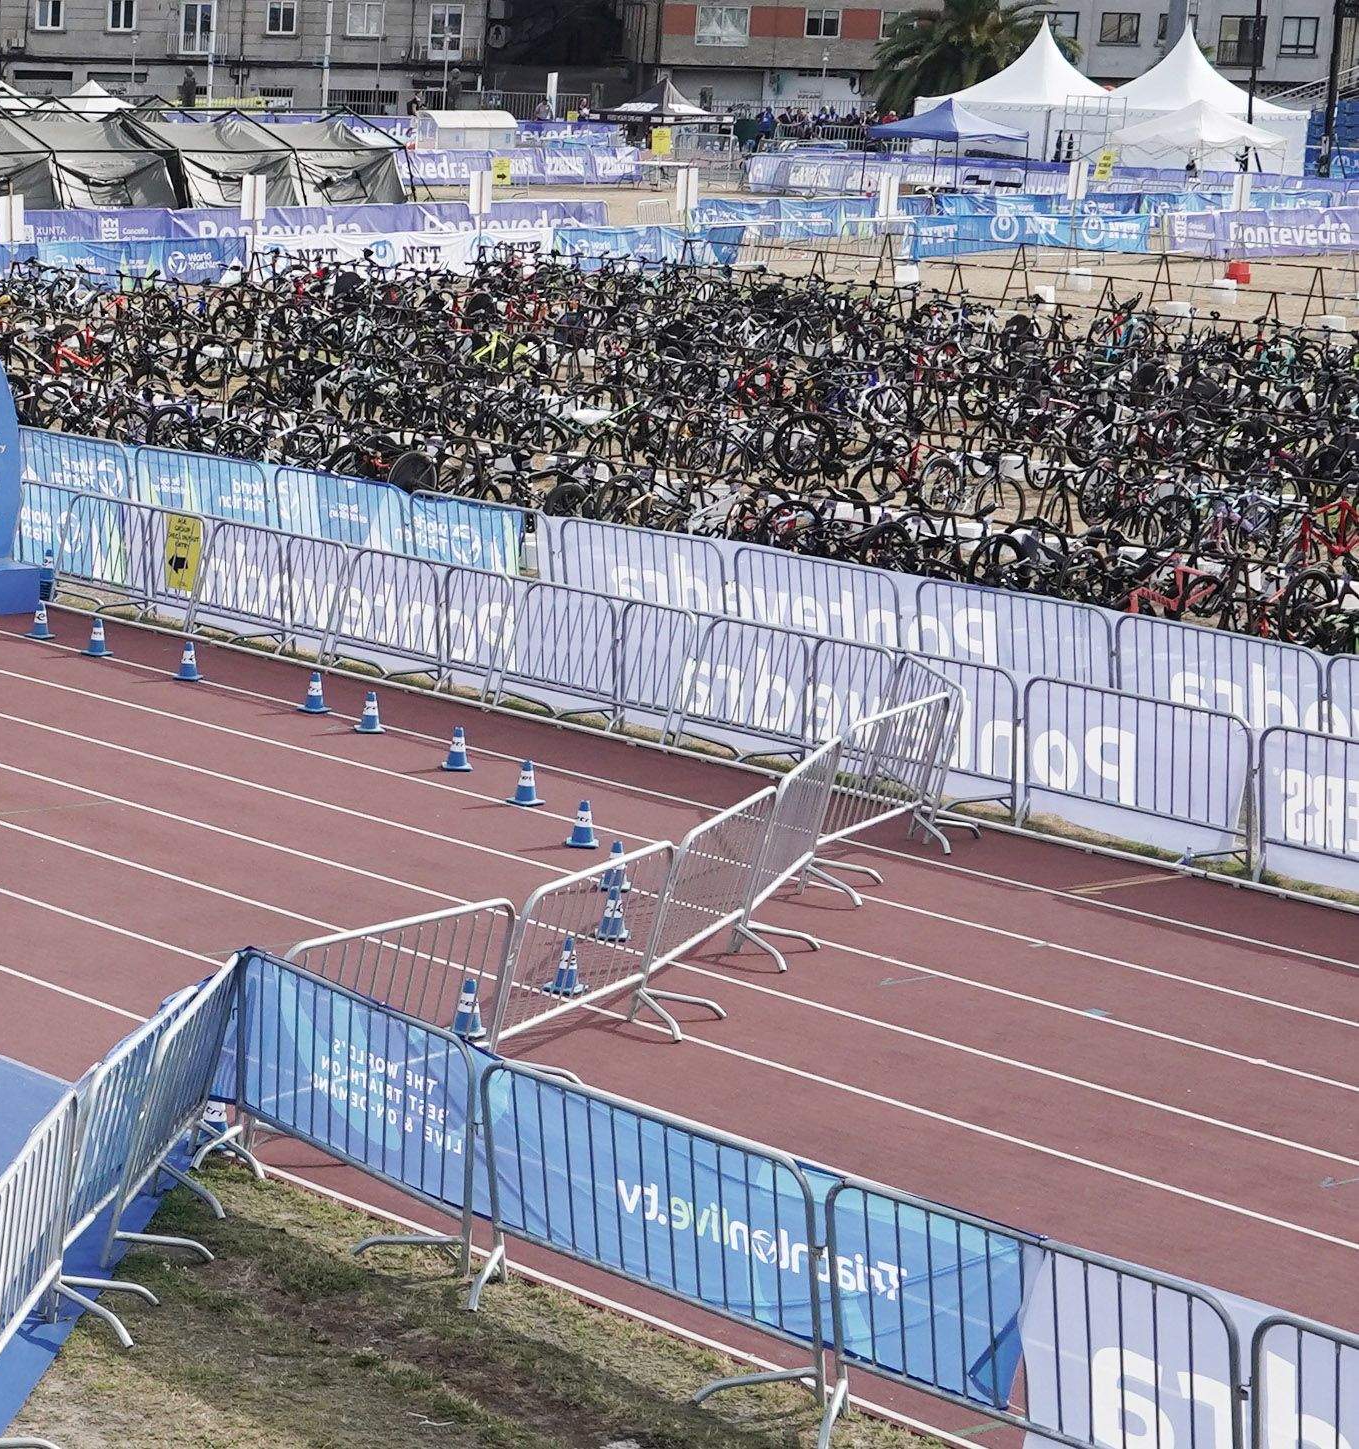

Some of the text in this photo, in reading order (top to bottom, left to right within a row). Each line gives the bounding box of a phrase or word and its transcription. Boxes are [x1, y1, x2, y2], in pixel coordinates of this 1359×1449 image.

[36, 227, 66, 236] XUNTA
[920, 224, 958, 244] NTT
[1025, 217, 1059, 234] NTT
[1109, 221, 1141, 238] NTT
[1229, 215, 1352, 249] Pontevedra
[187, 252, 213, 262] World
[402, 245, 442, 264] NTT
